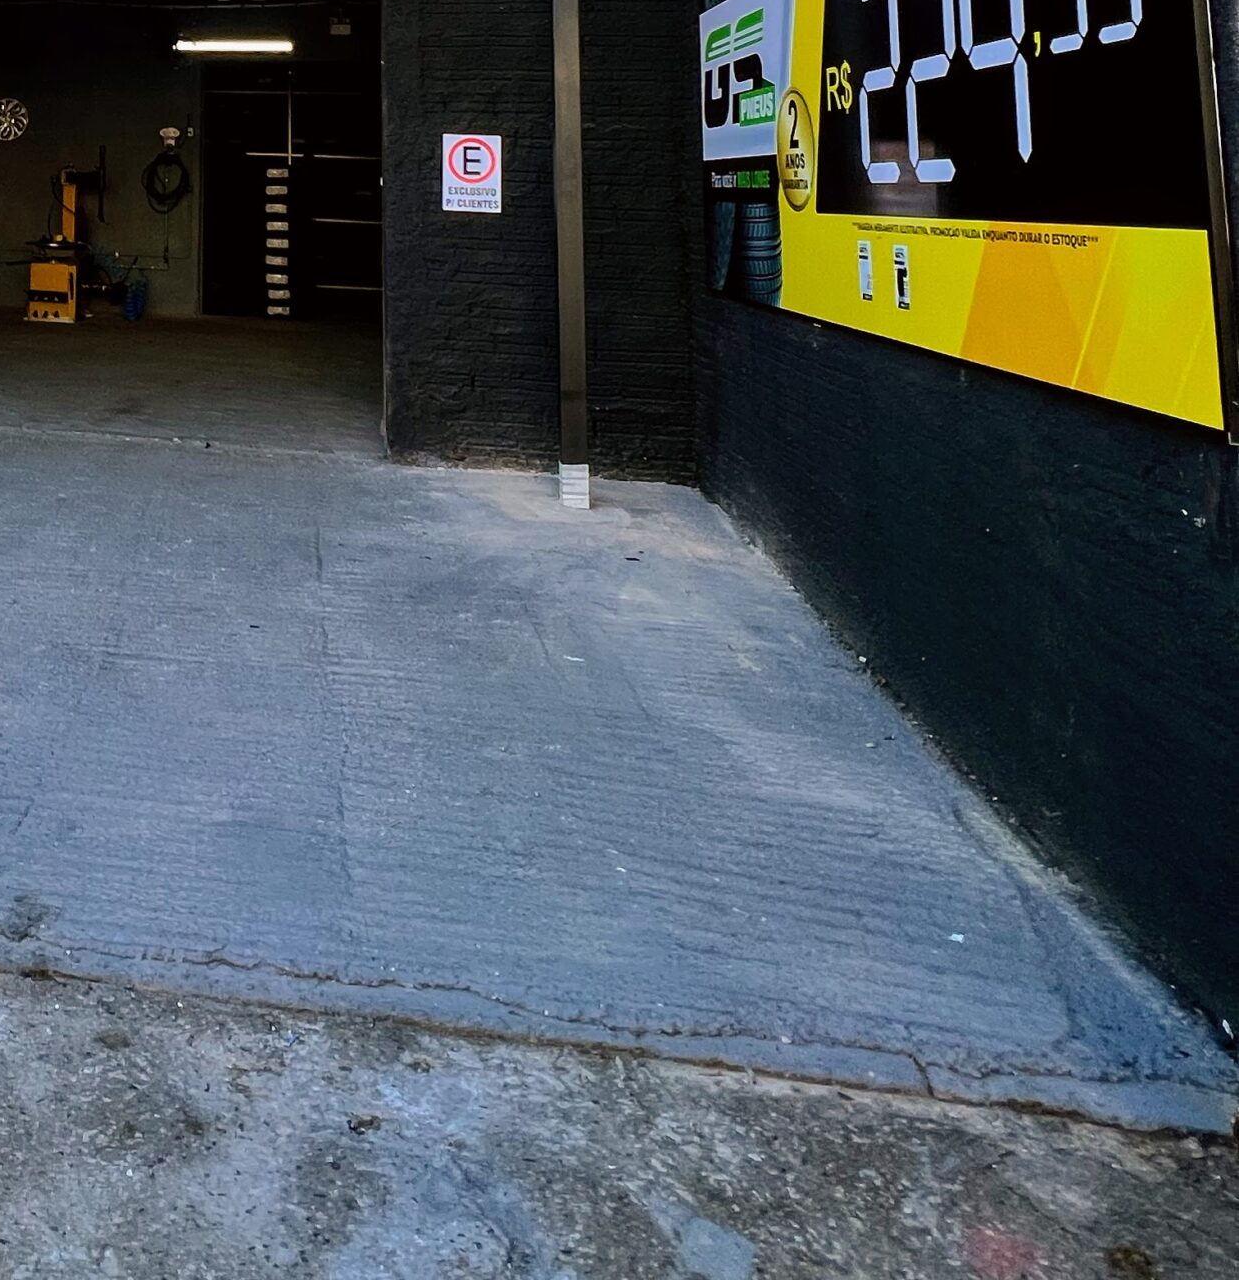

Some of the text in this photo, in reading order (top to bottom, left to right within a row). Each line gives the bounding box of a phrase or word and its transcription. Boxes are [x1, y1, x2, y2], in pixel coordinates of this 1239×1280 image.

[826, 60, 853, 114] R$
[741, 92, 774, 121] PNEUS
[788, 99, 800, 149] 2
[463, 146, 481, 175] E
[785, 153, 806, 169] ANOS
[448, 186, 497, 197] EXCLUSIVO
[445, 198, 499, 209] P/ CLIENTES
[982, 229, 1018, 242] ENQUANTO
[1019, 232, 1042, 244] DURAR
[1044, 233, 1050, 245] O
